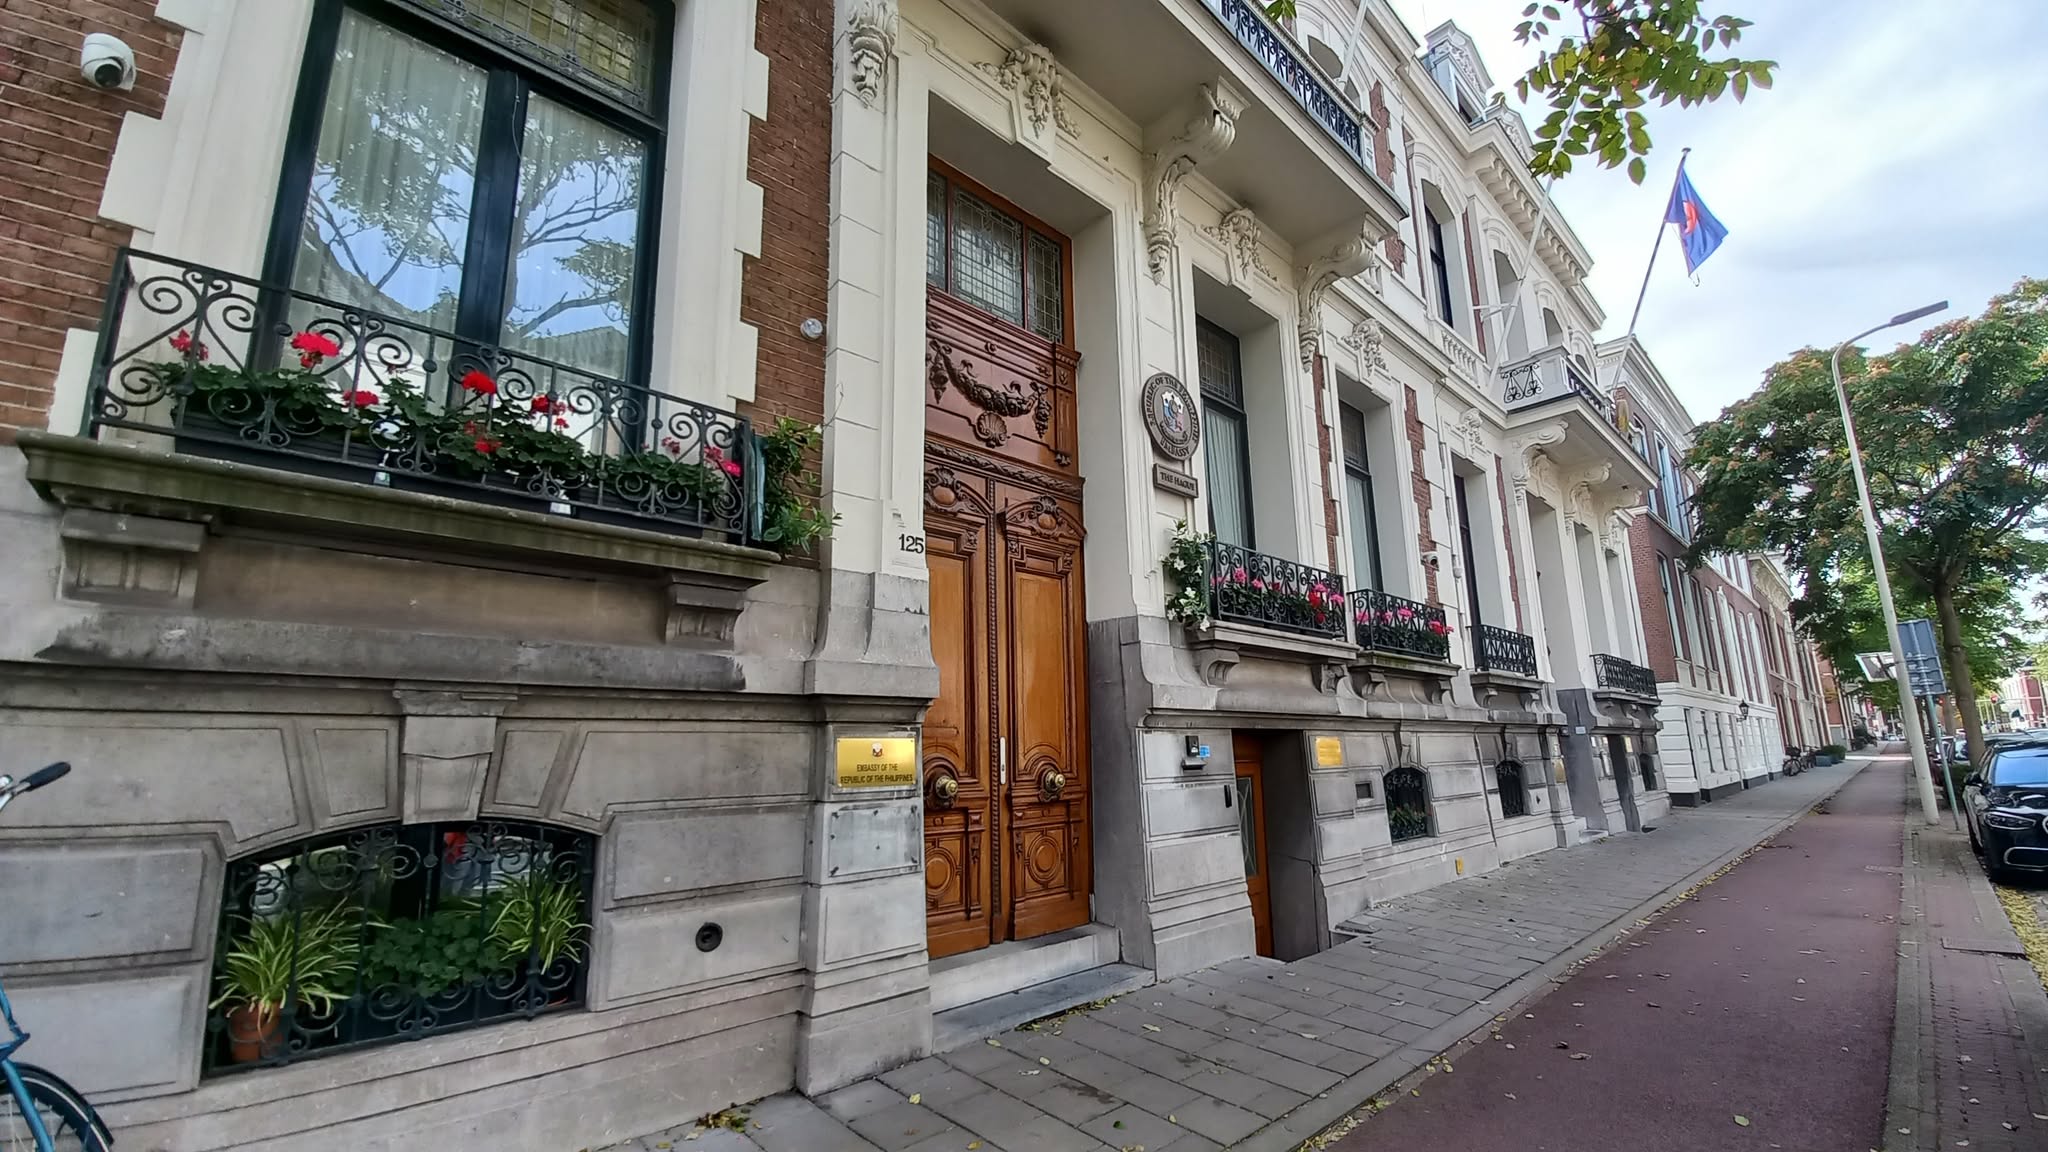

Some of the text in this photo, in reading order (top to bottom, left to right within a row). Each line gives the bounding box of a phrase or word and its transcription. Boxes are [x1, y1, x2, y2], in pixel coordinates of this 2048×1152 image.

[1160, 471, 1195, 491] THE HAGUE
[899, 534, 924, 554] 125
[857, 764, 880, 772] EMBASSY
[881, 764, 888, 772] OF
[840, 776, 865, 784] REPUBLIC
[884, 774, 912, 782] PHILIPPINES
